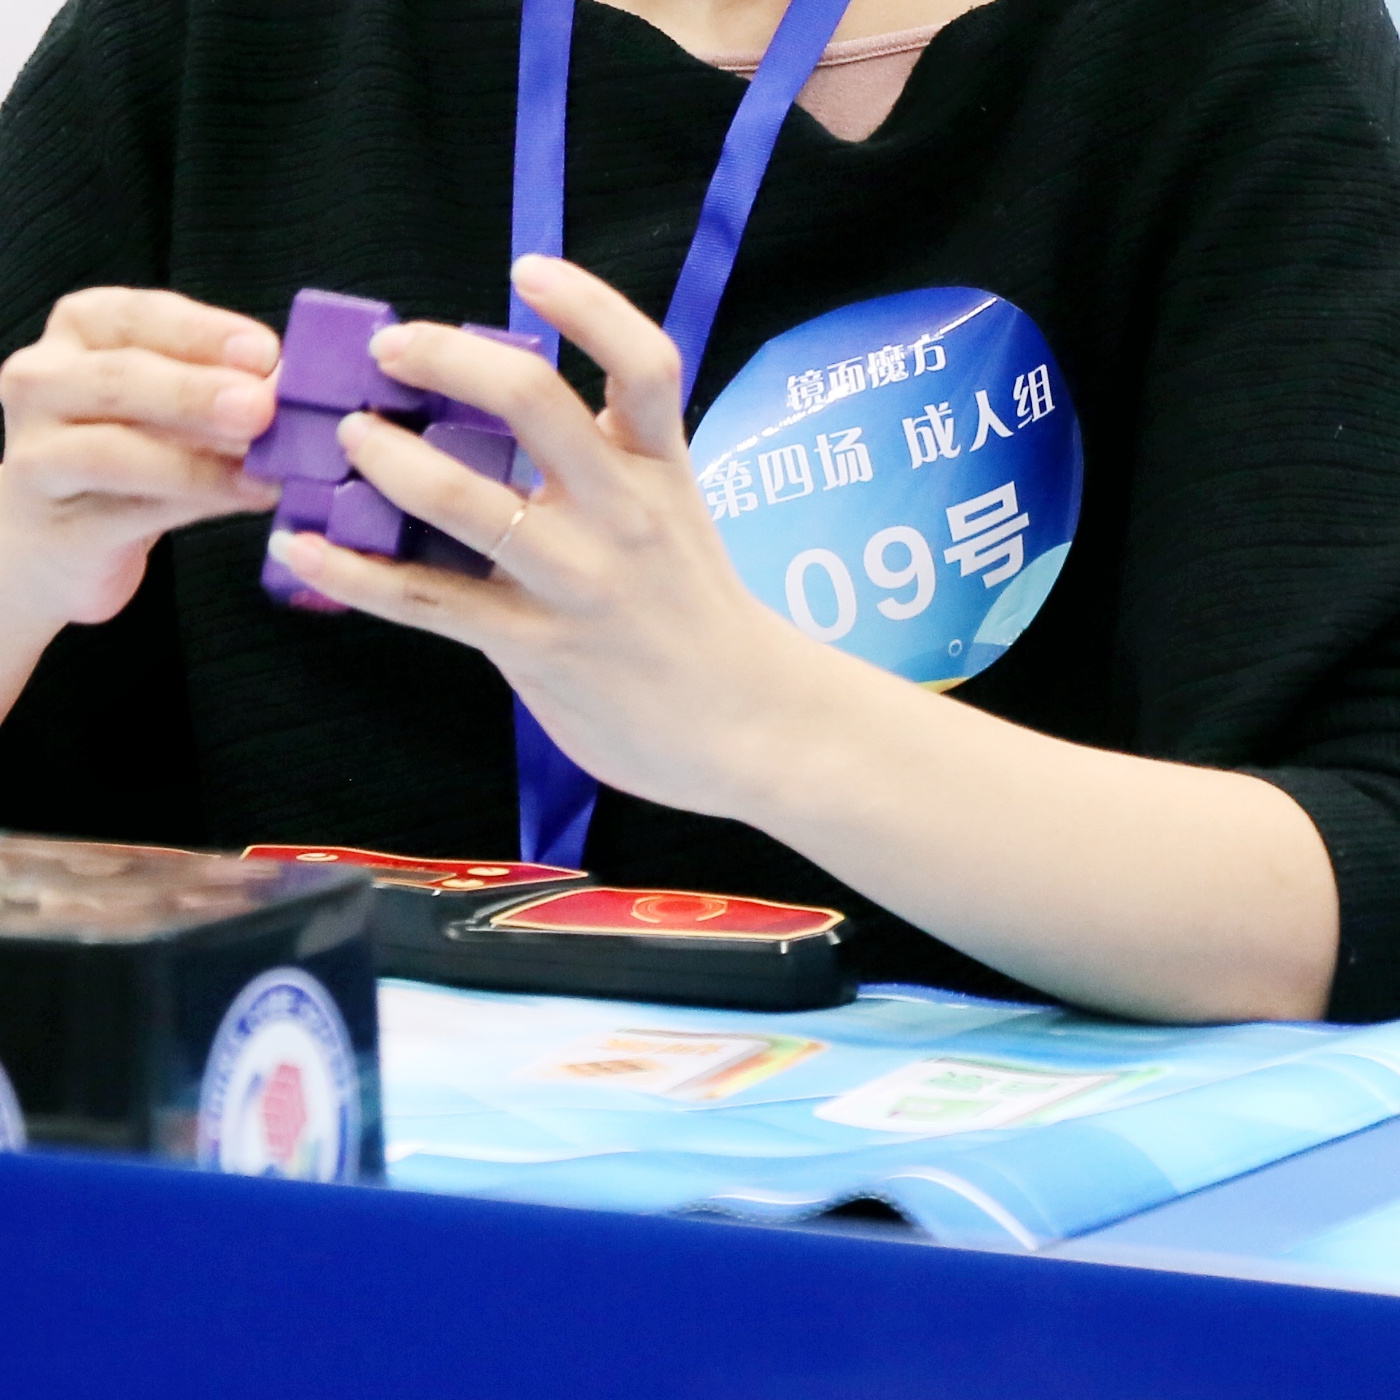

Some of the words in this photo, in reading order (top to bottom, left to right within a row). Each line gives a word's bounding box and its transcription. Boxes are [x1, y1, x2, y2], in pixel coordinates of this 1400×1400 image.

[701, 426, 874, 522] 第四场
[902, 364, 1056, 469] 成人组
[786, 334, 948, 411] 镜面魔方
[785, 481, 1030, 644] 09号
